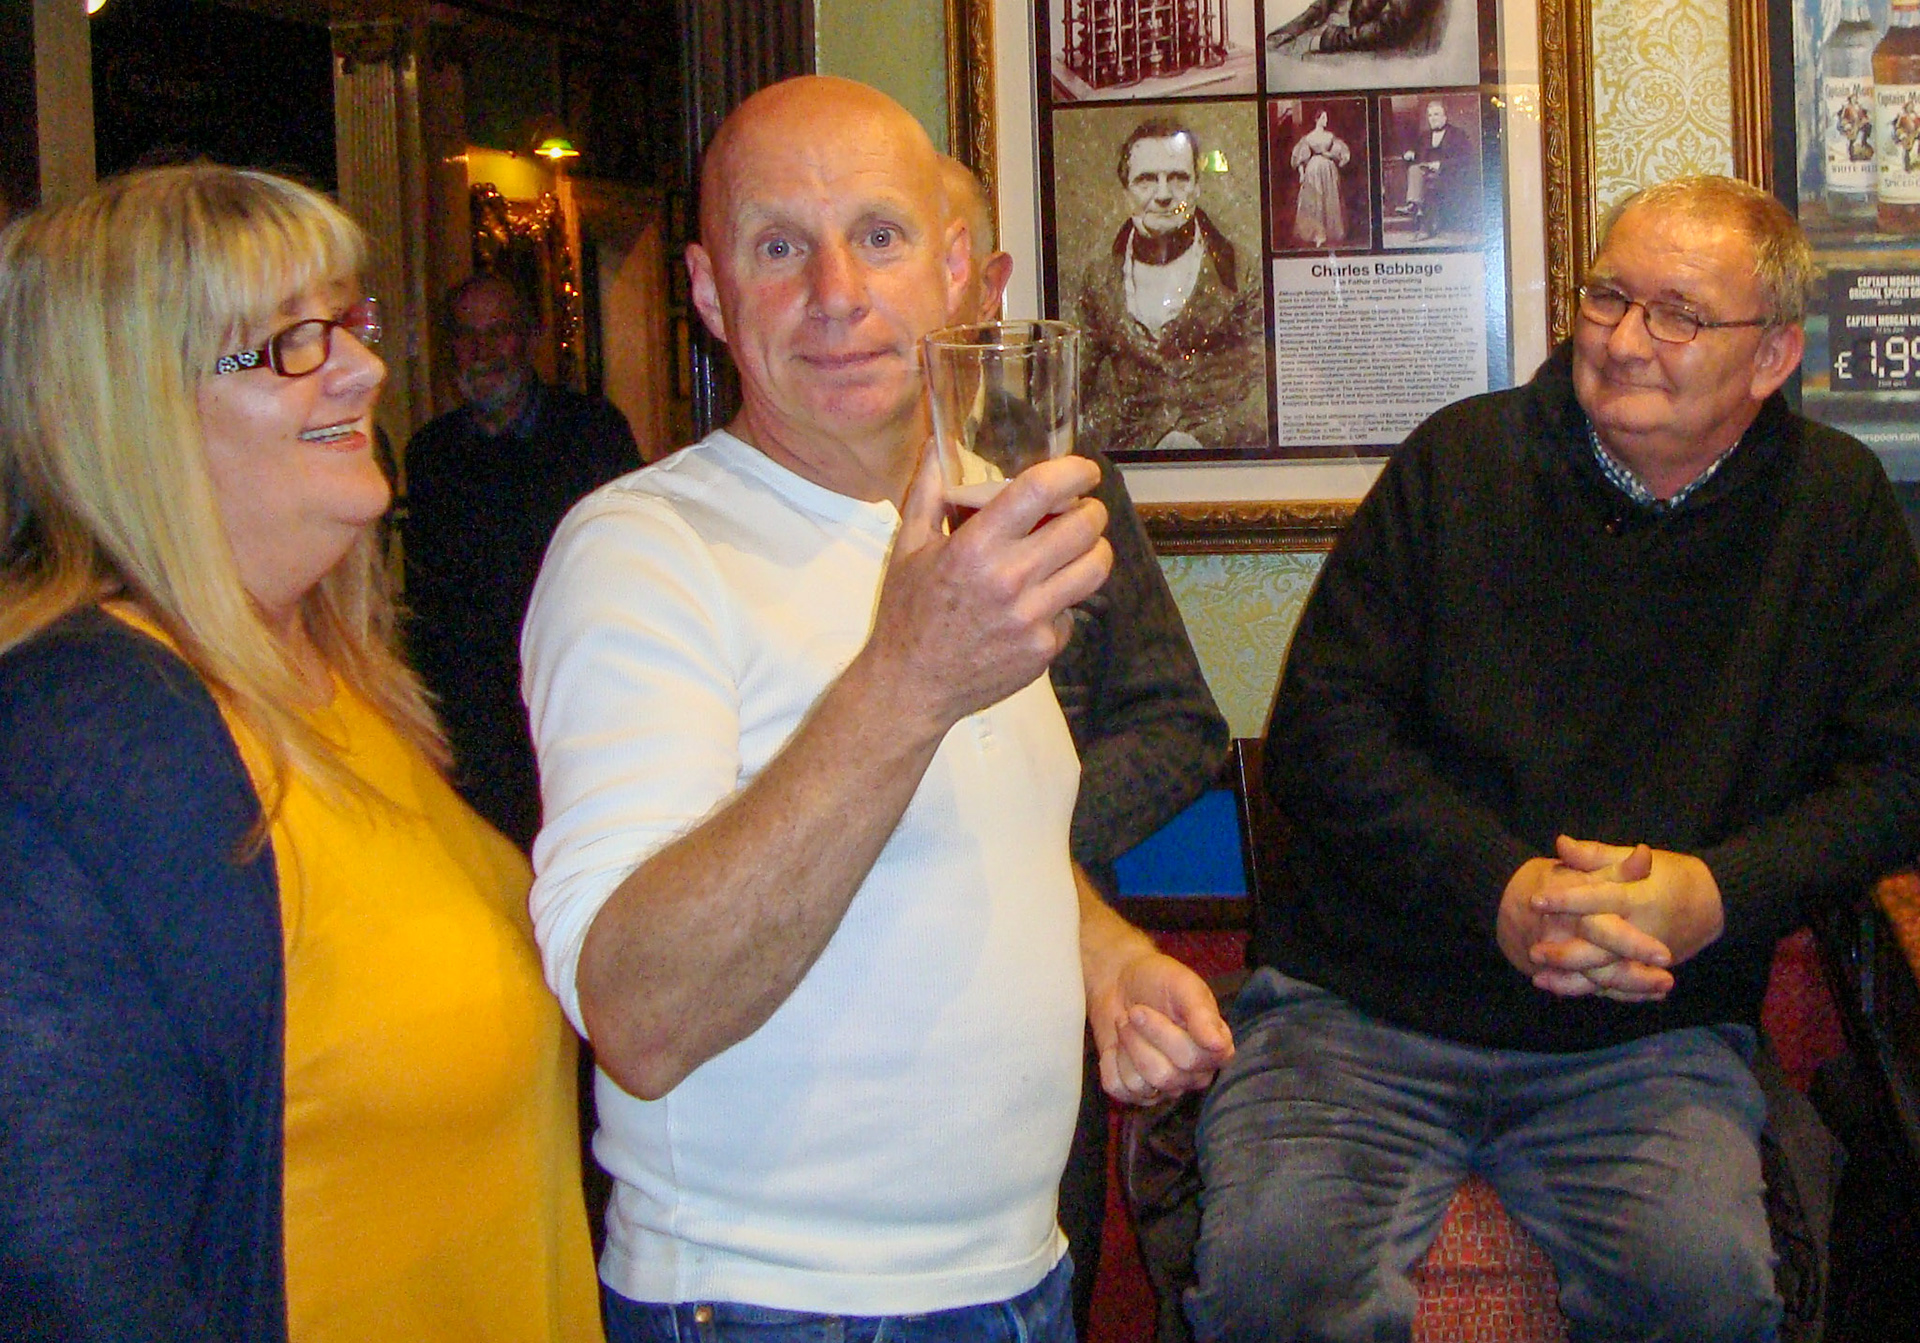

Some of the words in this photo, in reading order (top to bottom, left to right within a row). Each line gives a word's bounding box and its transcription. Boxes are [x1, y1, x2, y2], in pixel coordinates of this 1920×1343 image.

[1311, 264, 1370, 278] Charles
[1375, 263, 1443, 277] Babbage
[1857, 276, 1888, 287] CAPTAIN
[1849, 287, 1882, 299] ORIGINAL
[1846, 315, 1877, 327] CAPTAIN
[1878, 314, 1909, 327] MORGAN
